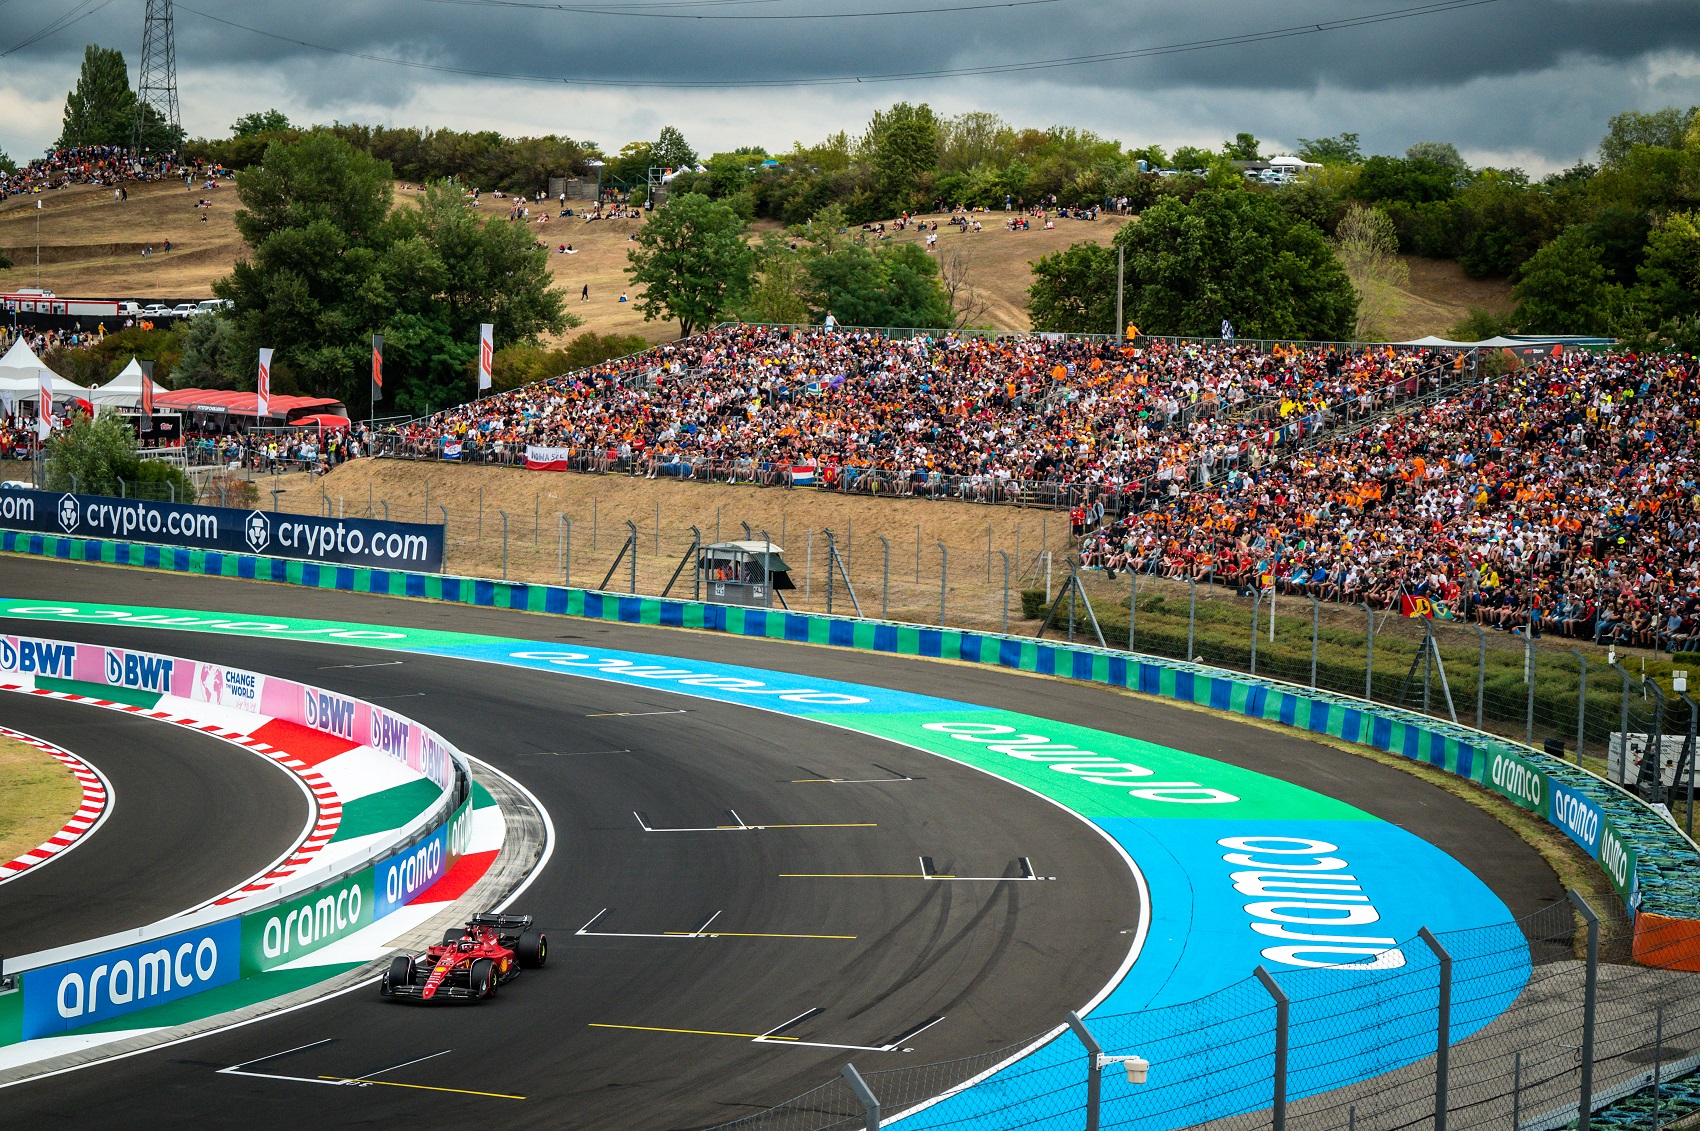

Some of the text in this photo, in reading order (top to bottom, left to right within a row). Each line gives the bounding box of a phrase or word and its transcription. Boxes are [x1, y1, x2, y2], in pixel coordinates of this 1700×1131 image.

[0, 496, 35, 521] om
[86, 503, 218, 539] crypto.com
[278, 522, 428, 561] crypto.com
[7, 606, 407, 640] aramco
[19, 640, 76, 677] BWT
[124, 653, 173, 692] BWT
[226, 671, 255, 687] CHANGE
[509, 651, 871, 704] aramco
[232, 685, 255, 699] WORLD
[318, 693, 355, 738] BWT
[382, 714, 409, 762] BWT
[428, 738, 445, 788] BWT
[921, 722, 1241, 804] aramco
[1492, 754, 1541, 806] aramco
[1555, 789, 1598, 846] aramco
[386, 837, 441, 905] aramco
[1601, 827, 1627, 887] aramco
[262, 883, 362, 959] aramco
[1216, 836, 1407, 971] aramco
[56, 937, 218, 1019] aramco
